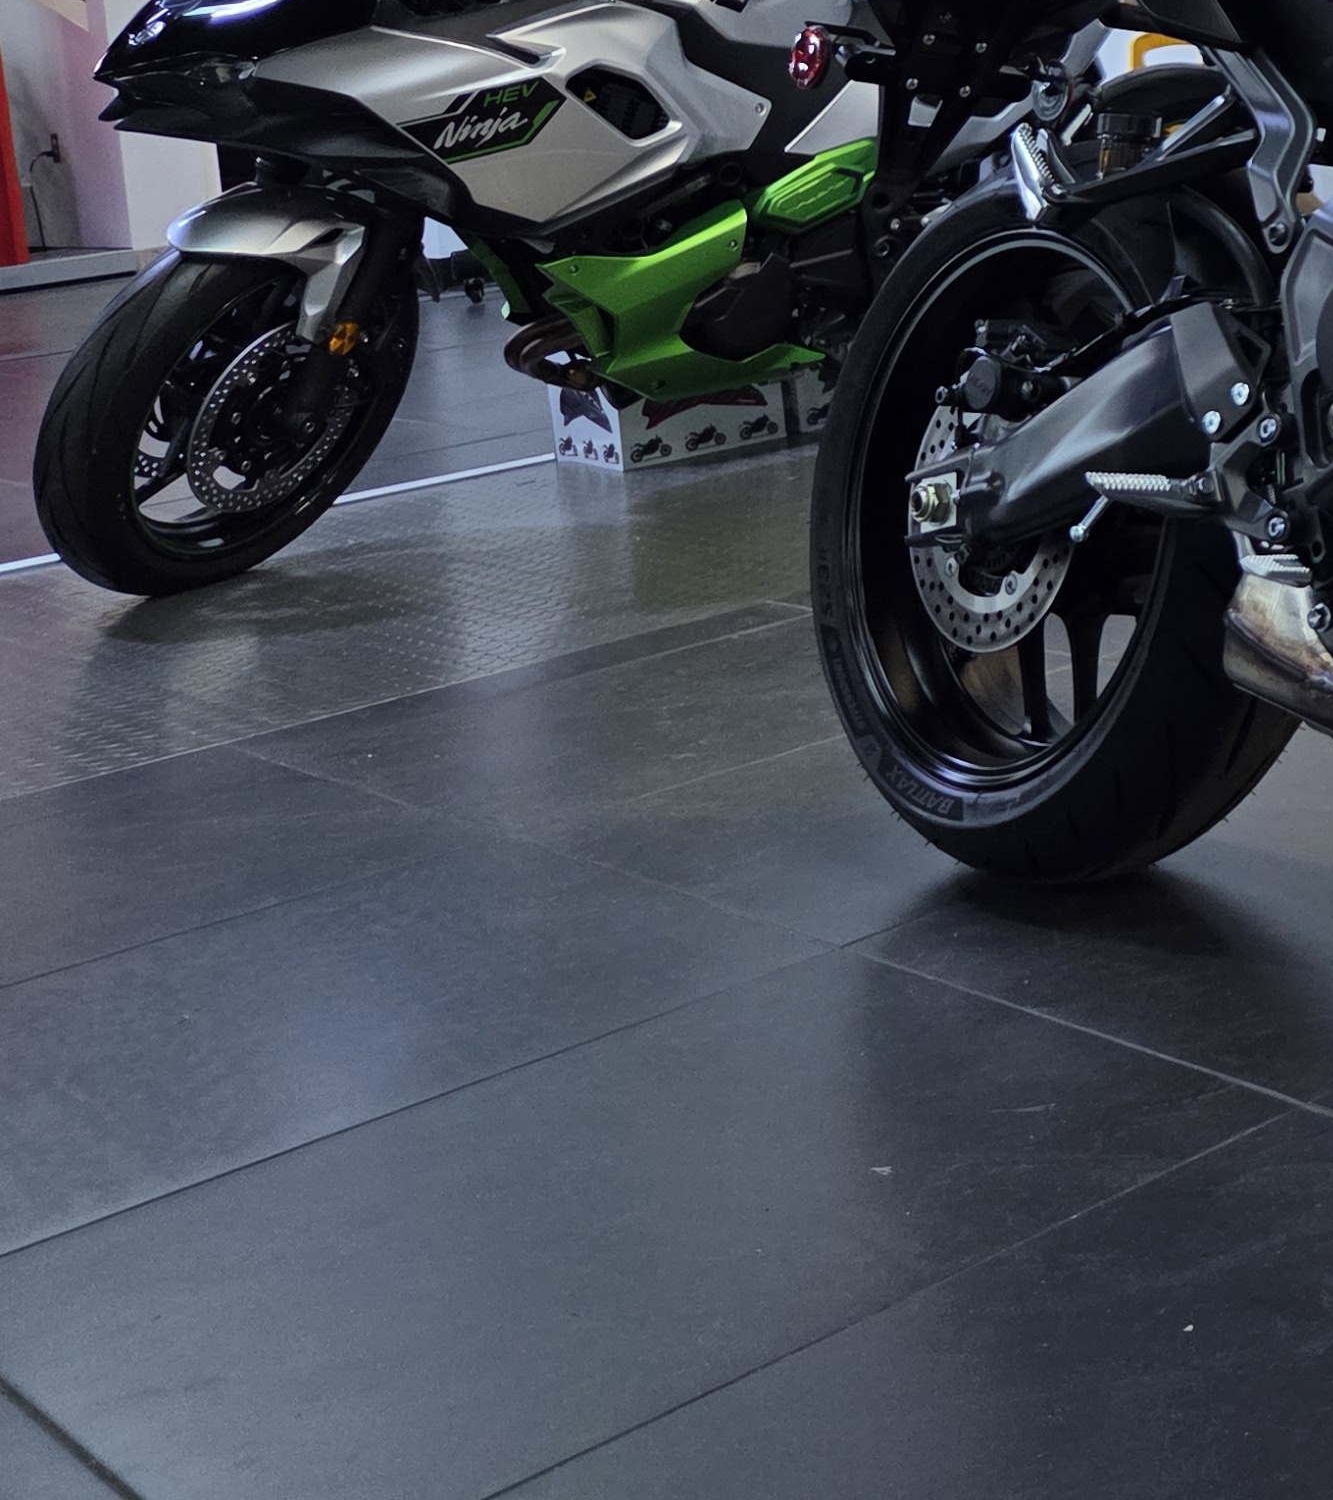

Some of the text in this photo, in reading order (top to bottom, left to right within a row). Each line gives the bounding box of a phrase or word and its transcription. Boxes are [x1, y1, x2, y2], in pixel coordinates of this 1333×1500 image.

[484, 80, 539, 107] HEV
[433, 106, 529, 150] Ninja
[885, 764, 954, 814] BATTLAX
